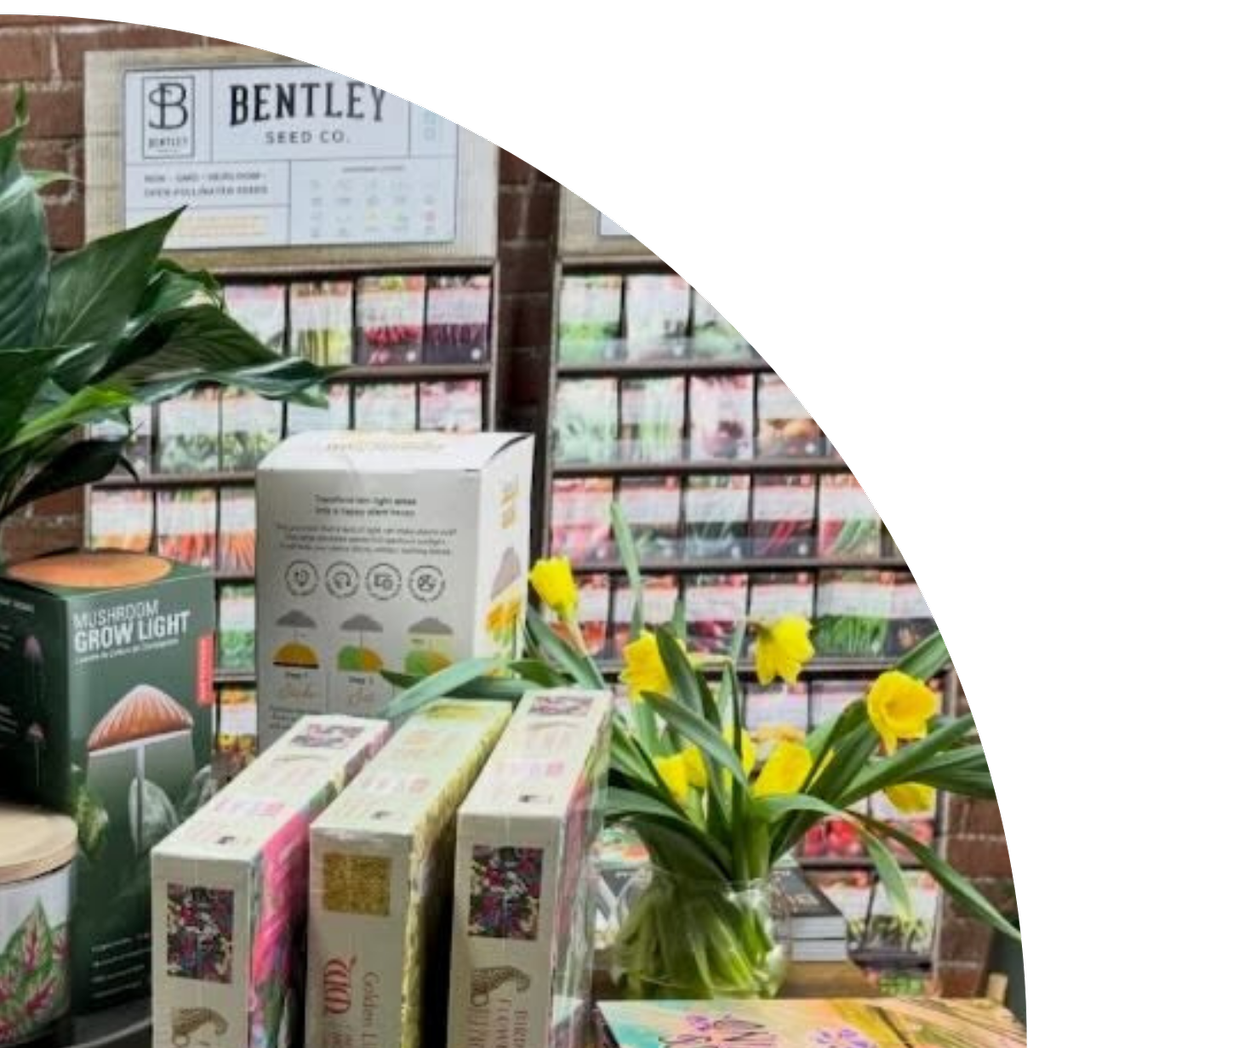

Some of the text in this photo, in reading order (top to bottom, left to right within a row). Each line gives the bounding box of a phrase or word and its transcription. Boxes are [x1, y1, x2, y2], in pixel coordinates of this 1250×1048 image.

[229, 82, 388, 127] BENTLEY
[265, 130, 350, 144] SEED CO.
[73, 599, 160, 630] MUSHROOM
[74, 620, 134, 653] GROW
[137, 610, 191, 641] LIGHT
